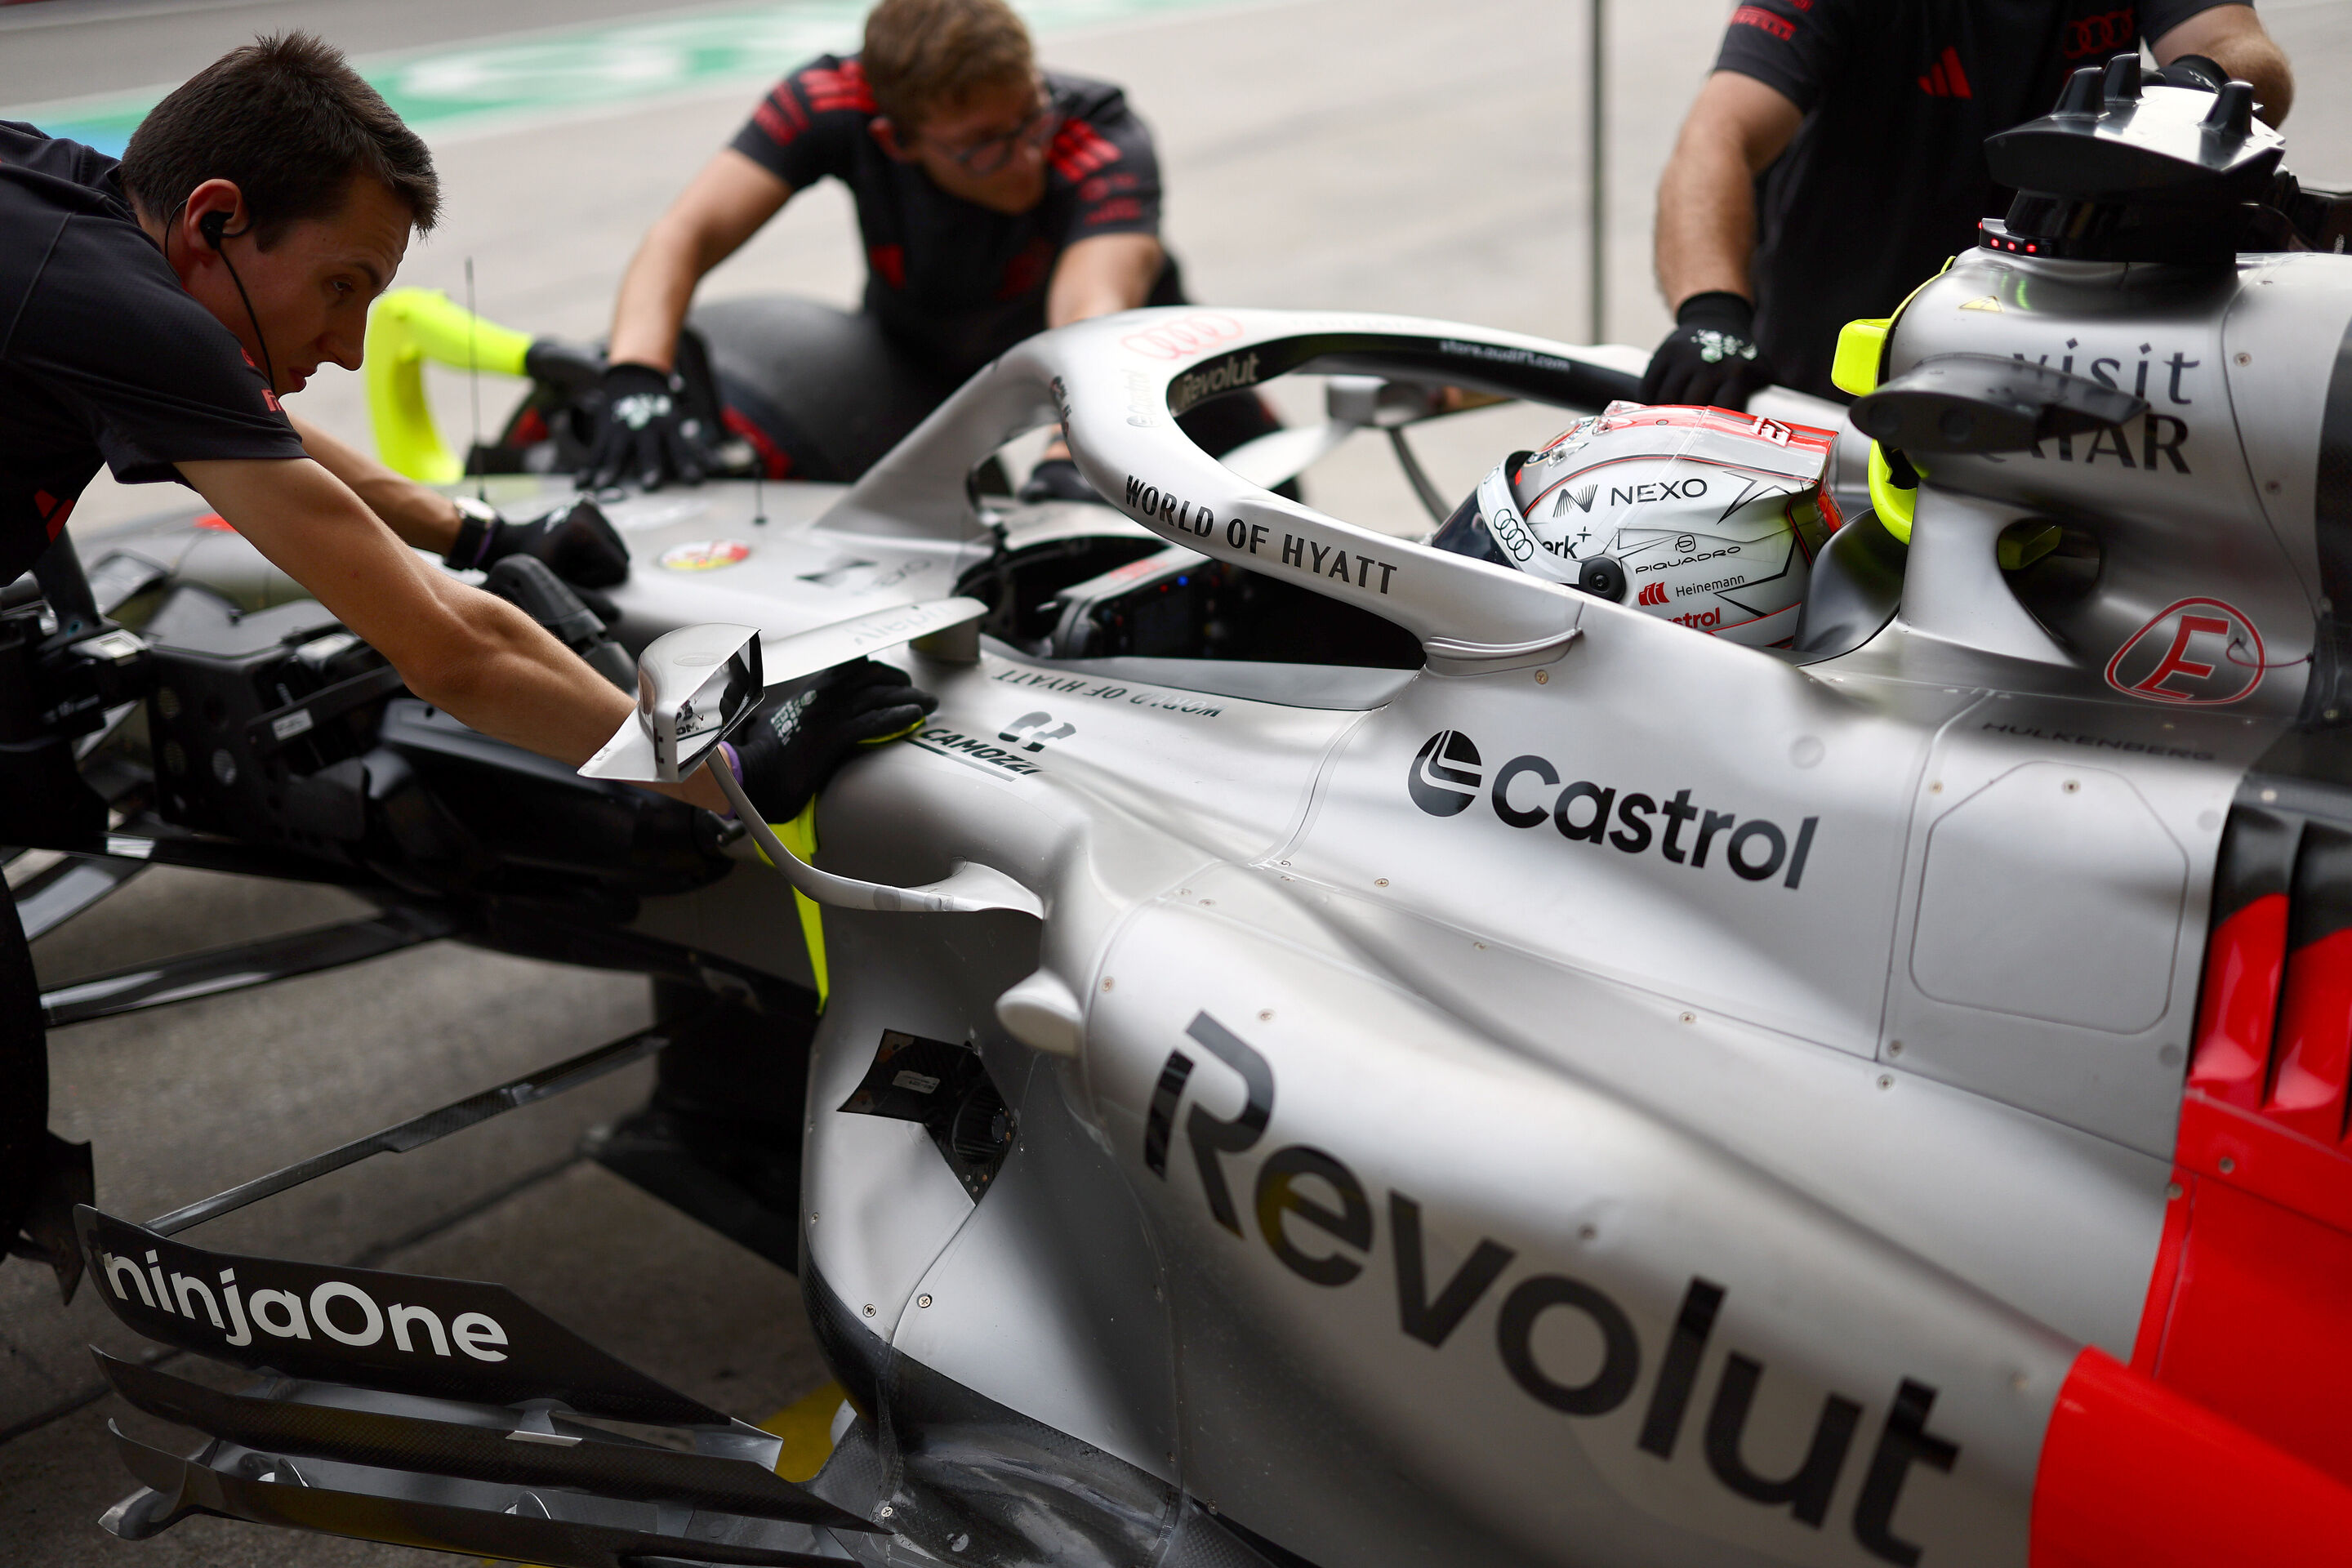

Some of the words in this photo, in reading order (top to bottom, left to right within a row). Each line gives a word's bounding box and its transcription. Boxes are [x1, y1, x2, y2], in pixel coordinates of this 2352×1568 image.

[1181, 353, 1259, 408] Revolut
[1610, 479, 1708, 506] NEXO
[1125, 474, 1214, 537] WORLD
[1227, 519, 1269, 555] OF
[1281, 533, 1397, 595] HYATT
[1636, 546, 1740, 573] PIQUADRO
[1676, 575, 1744, 597] Heinemann
[991, 670, 1088, 693] HYATT
[1082, 686, 1128, 699] OF
[1983, 723, 2214, 761] HULKENBERG
[1491, 755, 1820, 890] Castrol
[103, 1249, 509, 1362] ninjaOne
[1145, 1009, 1958, 1568] Revolut
